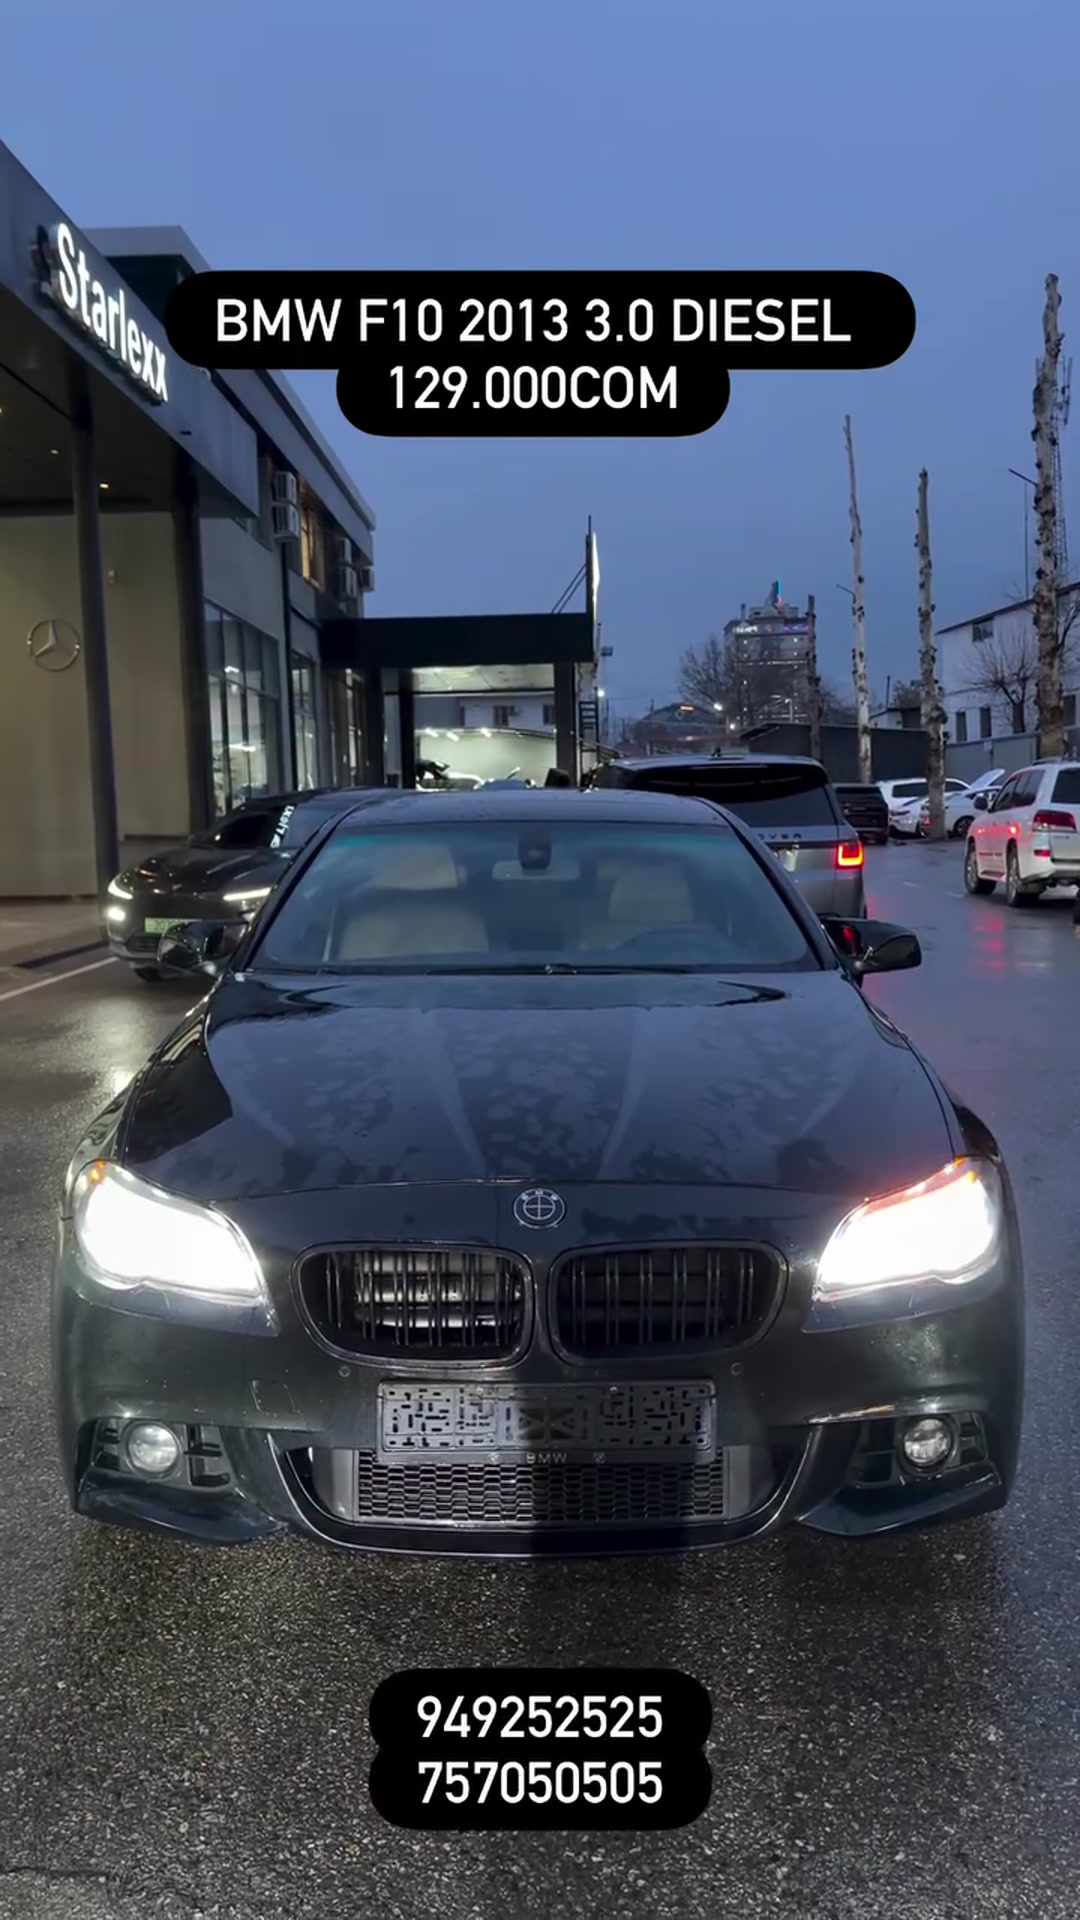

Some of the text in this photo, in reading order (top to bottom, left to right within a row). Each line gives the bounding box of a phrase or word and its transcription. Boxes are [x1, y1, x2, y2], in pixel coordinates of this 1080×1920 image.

[57, 223, 168, 401] Starlexx
[757, 833, 802, 841] OVER
[526, 1453, 567, 1464] BMW
